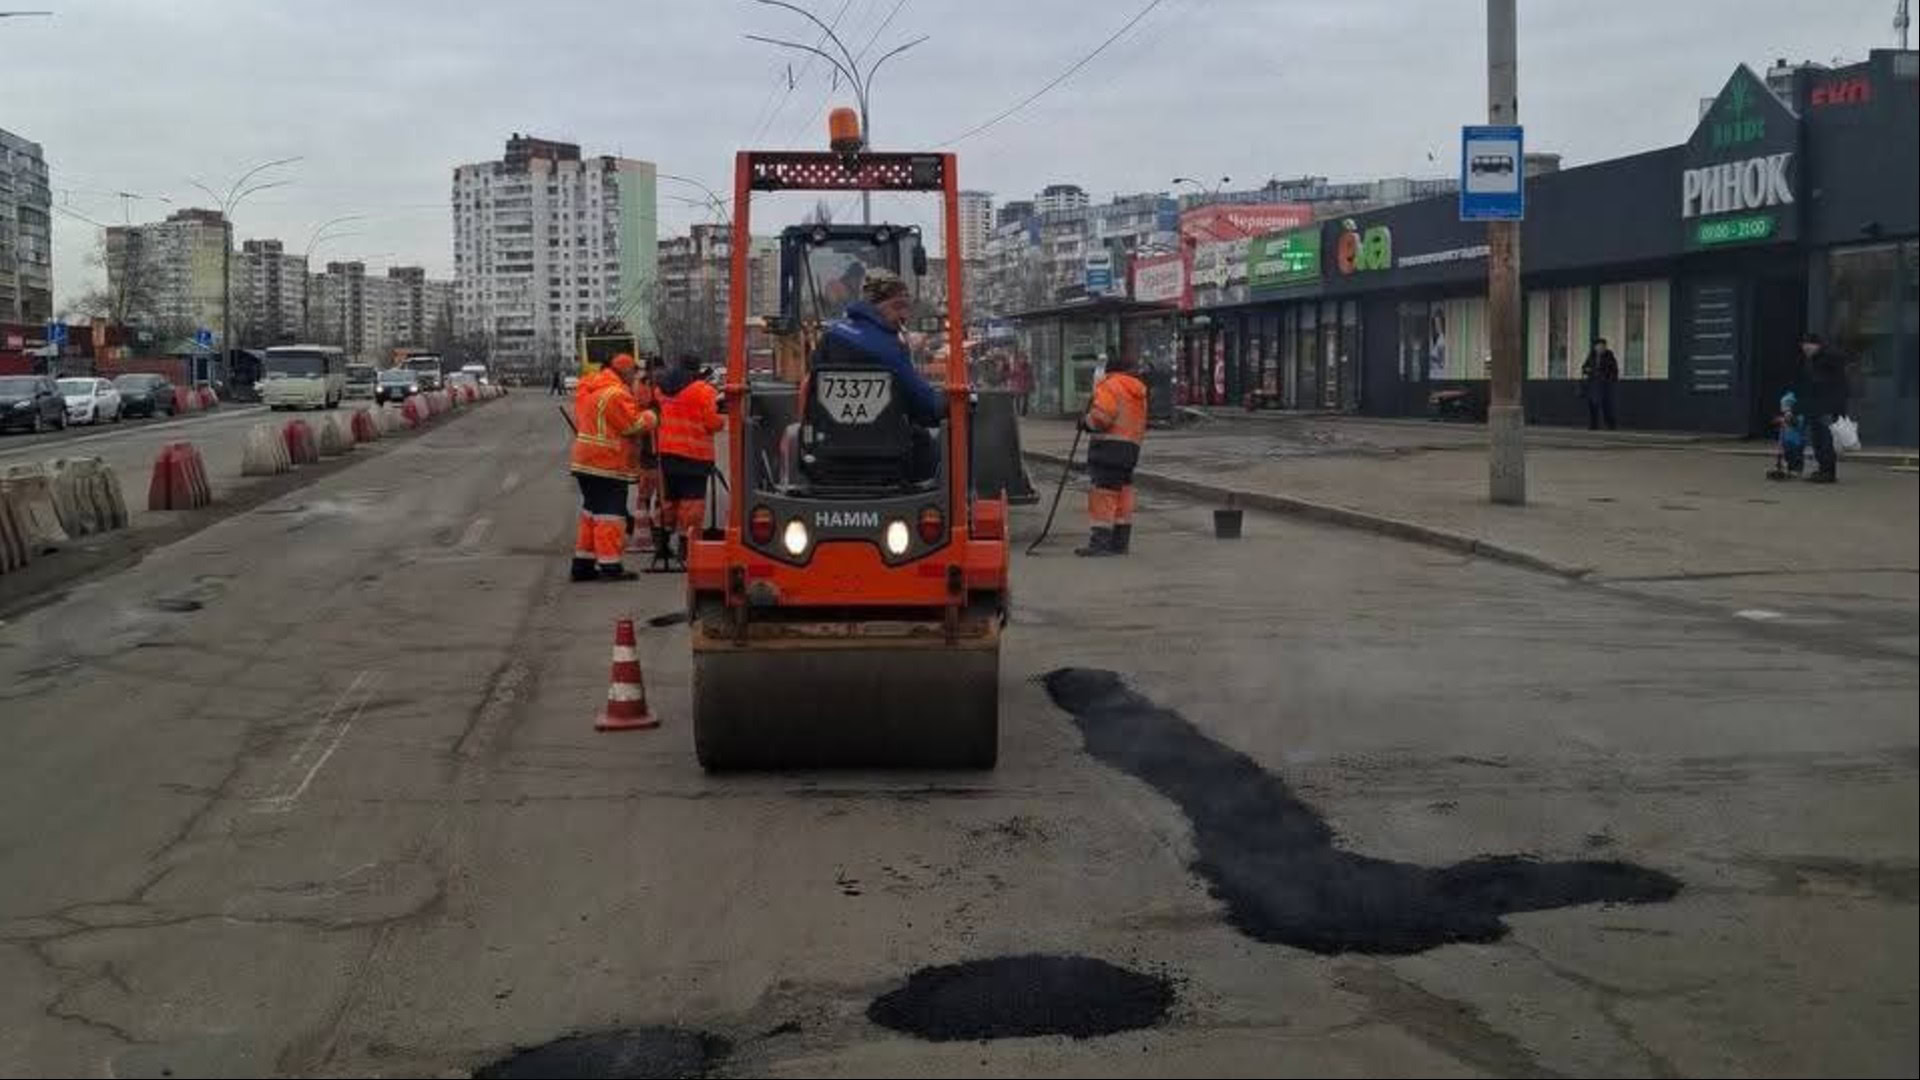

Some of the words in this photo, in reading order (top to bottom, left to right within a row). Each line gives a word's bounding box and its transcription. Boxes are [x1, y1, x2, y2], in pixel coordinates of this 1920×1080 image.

[1682, 152, 1795, 218] РИНОК
[823, 378, 886, 399] 73377
[840, 403, 868, 418] AA
[815, 512, 879, 527] HAMM
